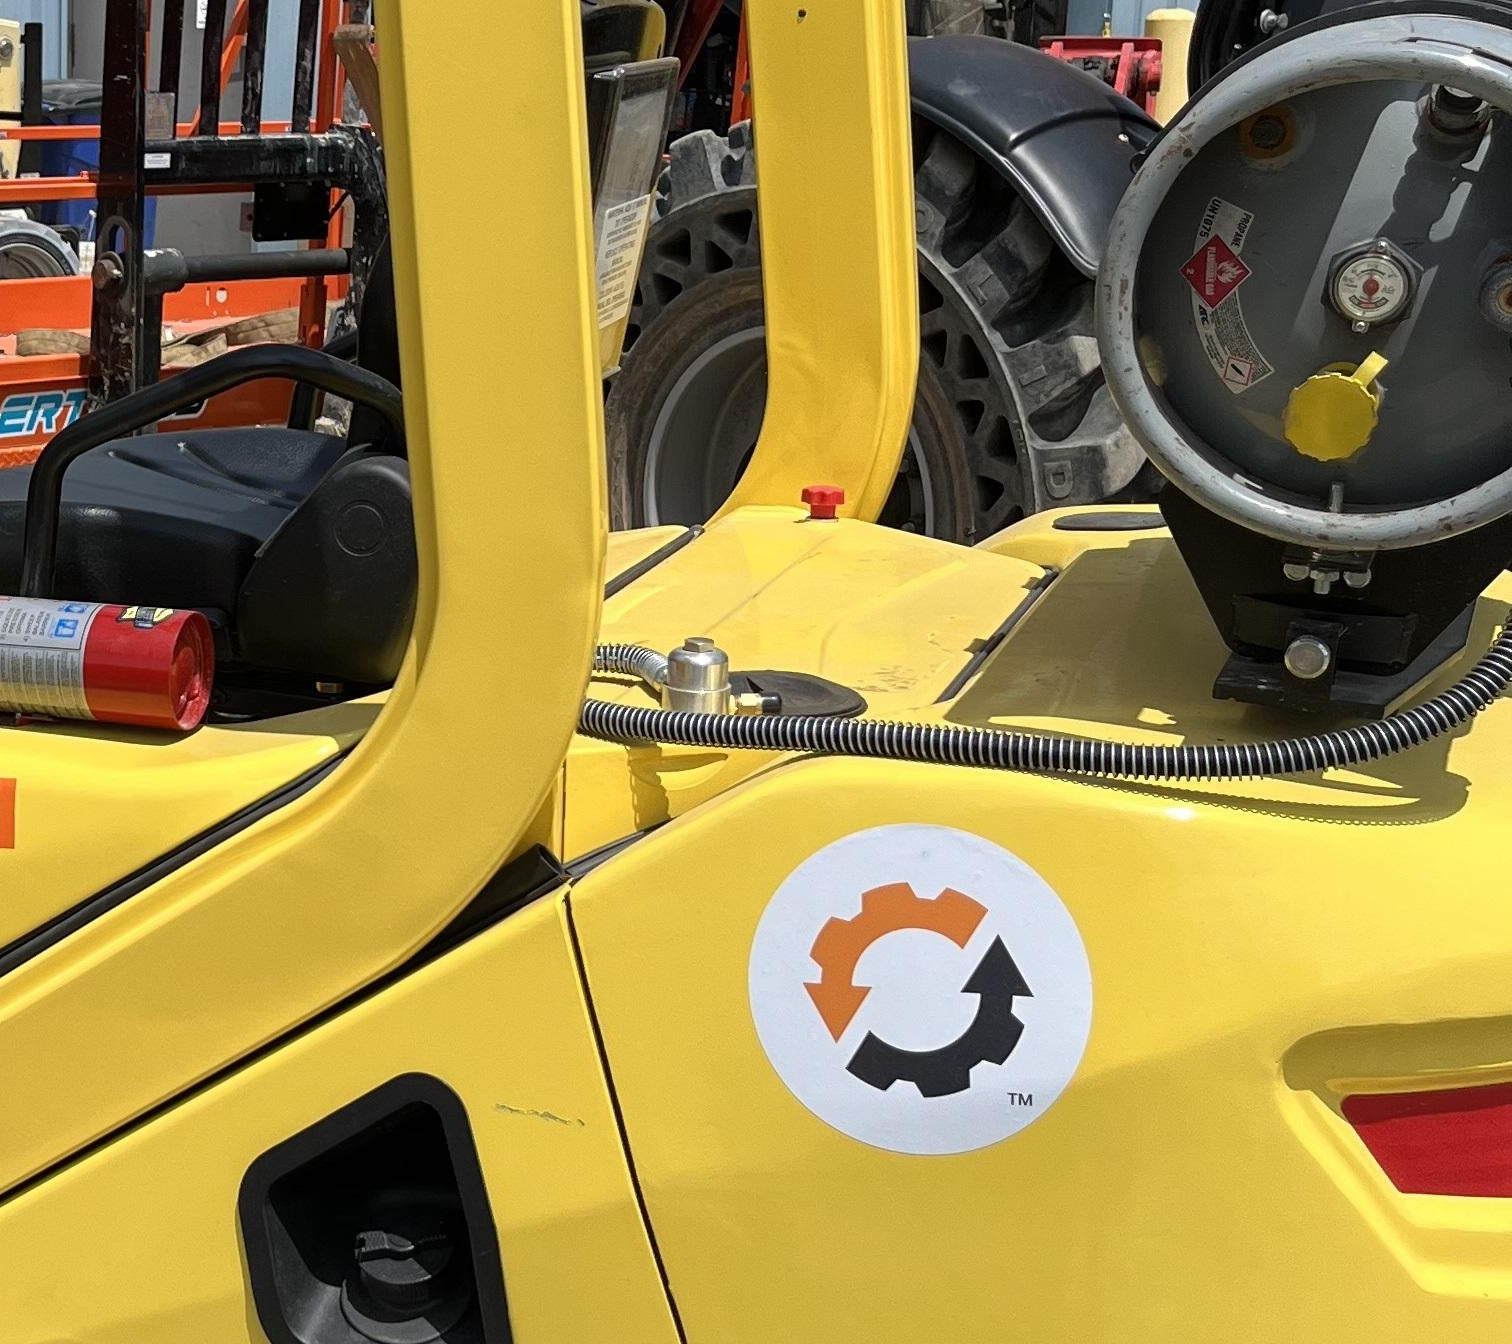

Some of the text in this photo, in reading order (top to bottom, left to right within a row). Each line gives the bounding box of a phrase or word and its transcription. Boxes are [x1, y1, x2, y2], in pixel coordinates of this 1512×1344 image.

[1200, 197, 1221, 239] UN1075
[1231, 212, 1252, 248] PROPANE
[1007, 1092, 1032, 1106] TM
